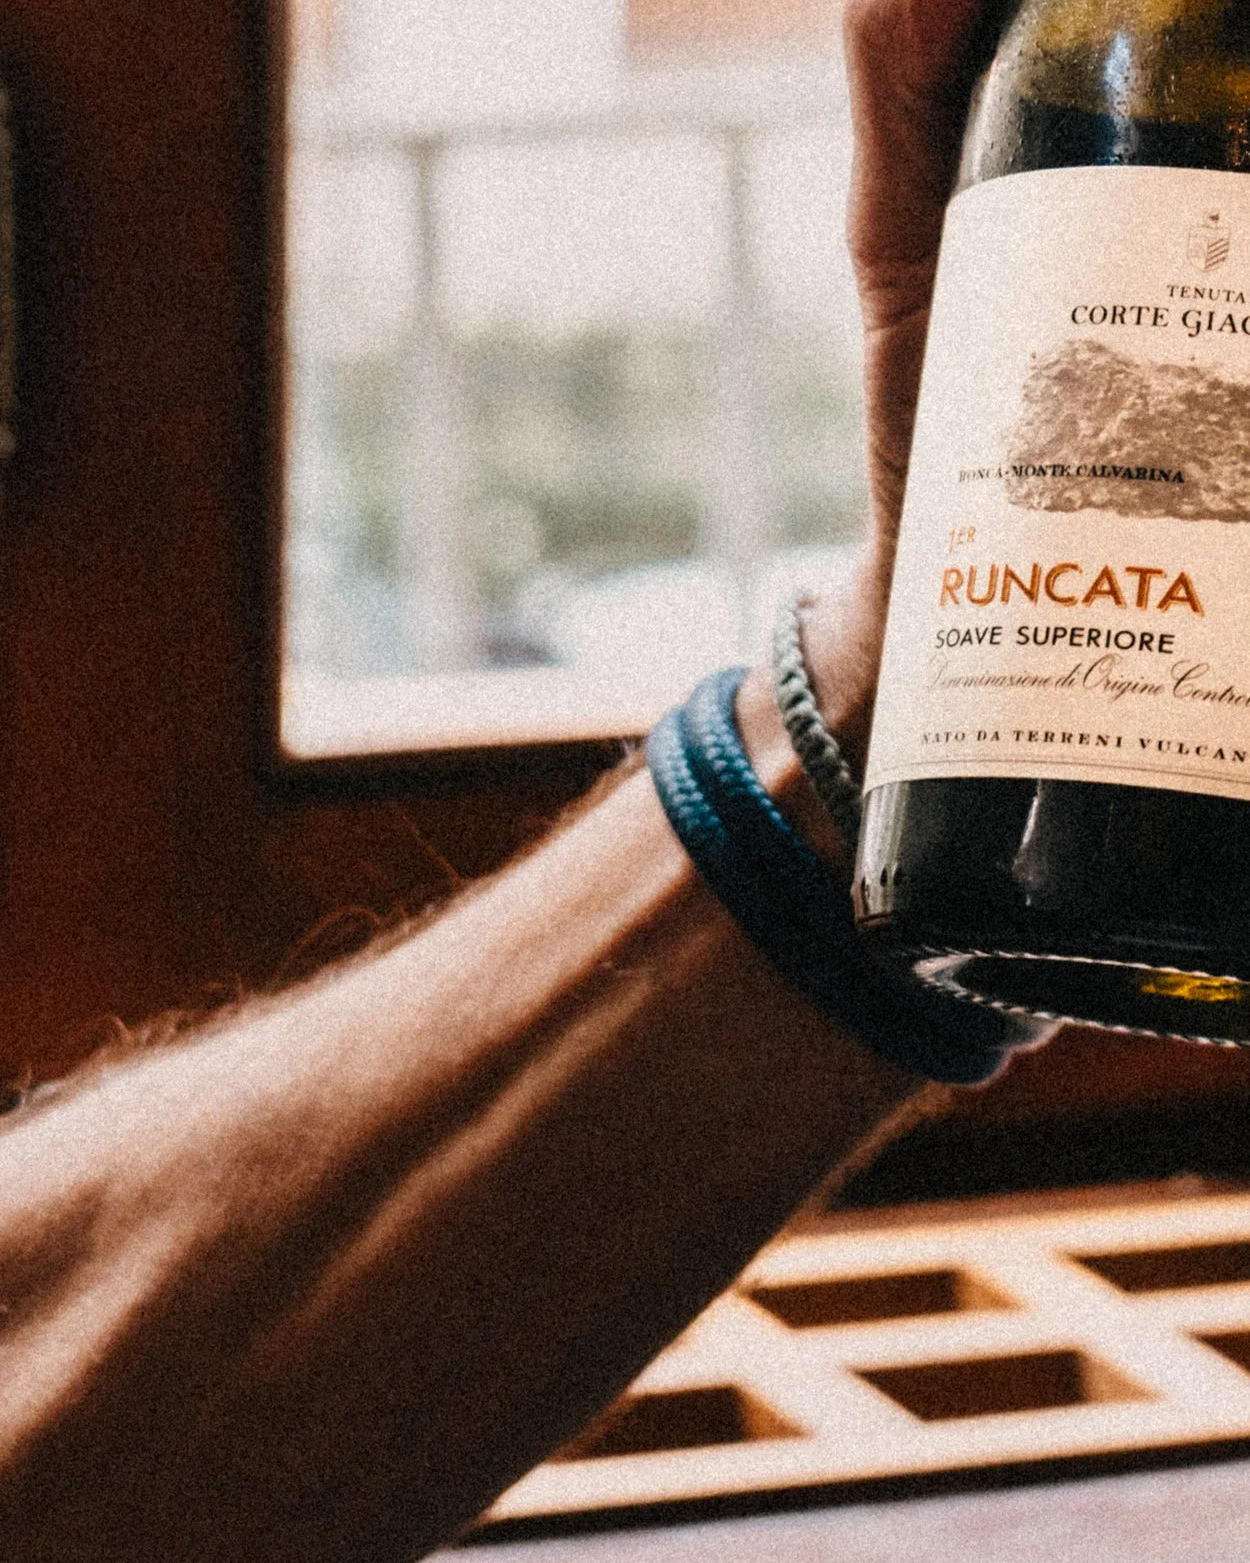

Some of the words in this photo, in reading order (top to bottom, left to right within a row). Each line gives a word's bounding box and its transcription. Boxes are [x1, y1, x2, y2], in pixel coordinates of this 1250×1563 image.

[1166, 284, 1246, 304] TENUTA
[1071, 305, 1170, 327] CORTE
[1075, 465, 1184, 484] CALVARINA
[938, 562, 1205, 617] RUNCATA
[935, 626, 1004, 649] SOAVE
[1016, 625, 1175, 654] SUPERIORE
[1054, 662, 1083, 688] di
[1082, 652, 1167, 704] Origine
[921, 731, 967, 746] NATO
[975, 729, 1001, 742] DA
[1012, 729, 1124, 749] TERRENI
